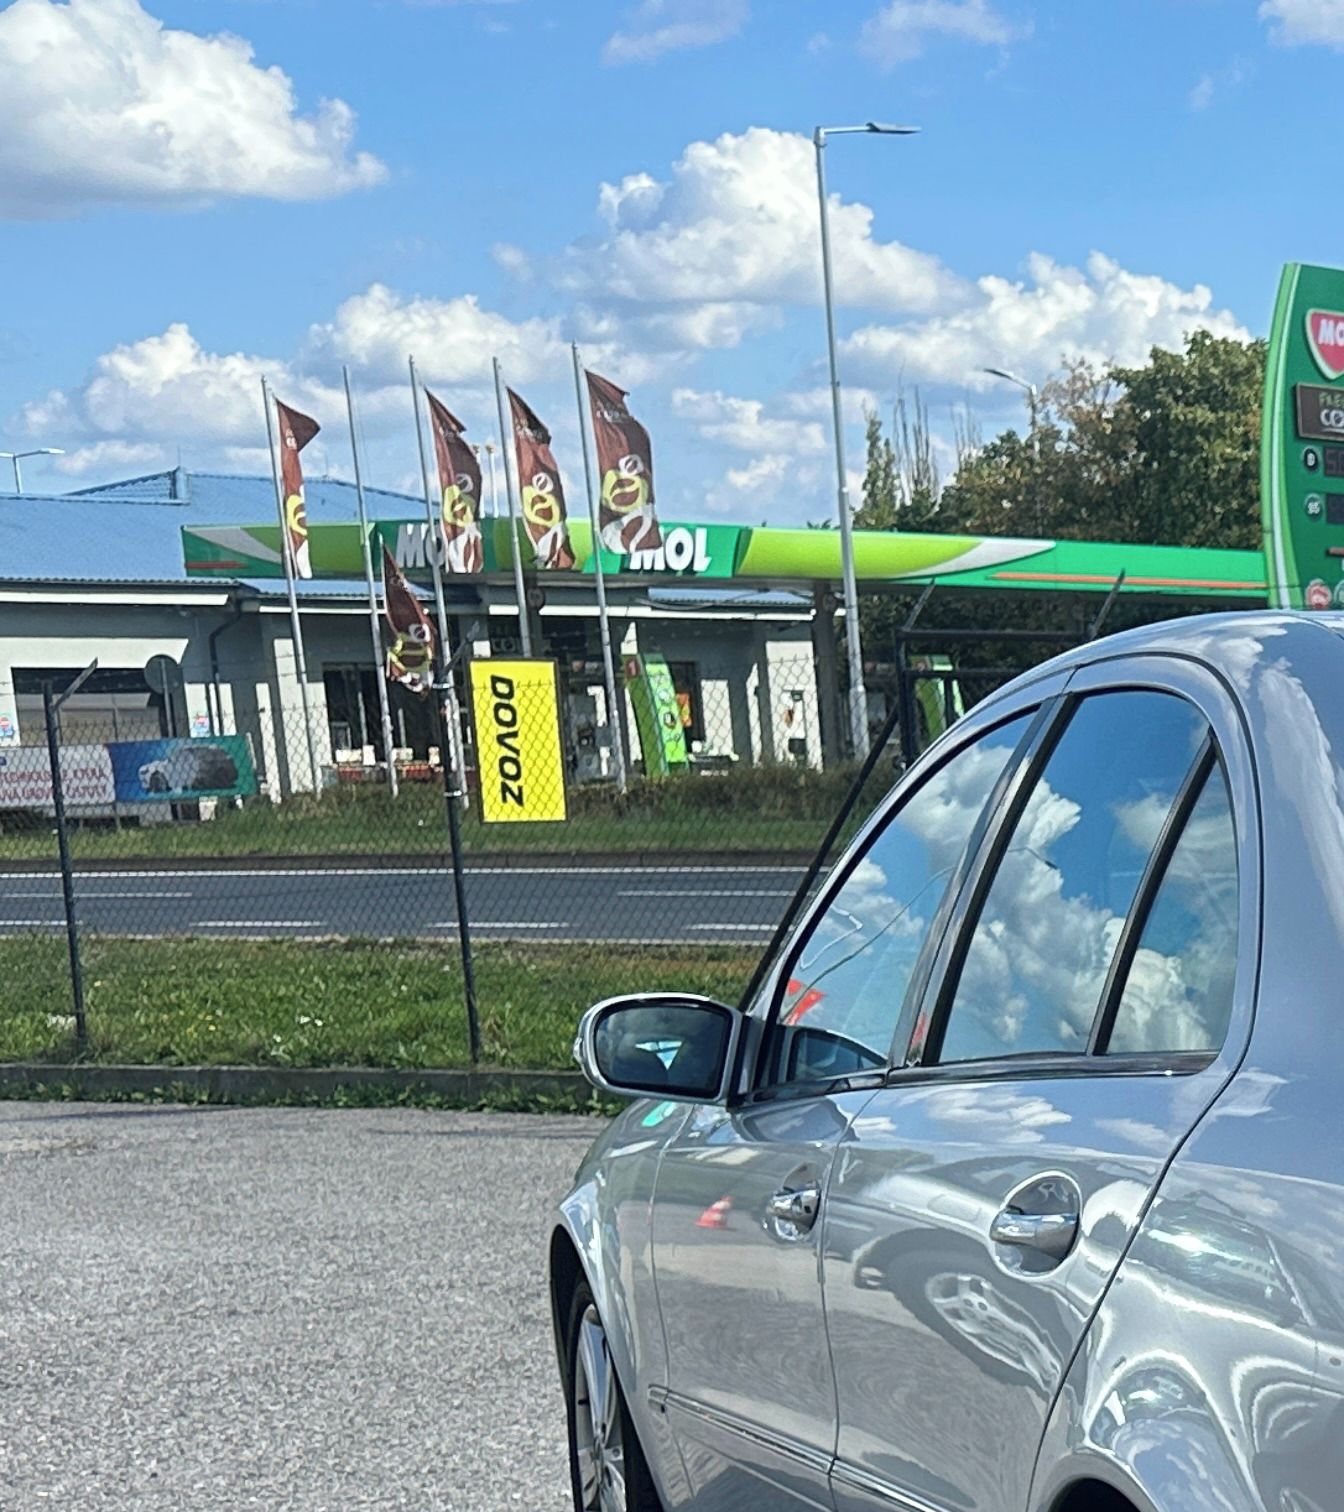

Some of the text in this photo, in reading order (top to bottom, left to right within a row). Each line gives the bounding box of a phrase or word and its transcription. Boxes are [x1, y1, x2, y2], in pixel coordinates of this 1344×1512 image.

[396, 523, 447, 568] MO
[629, 527, 712, 571] MOL
[490, 675, 524, 806] DOVOZ
